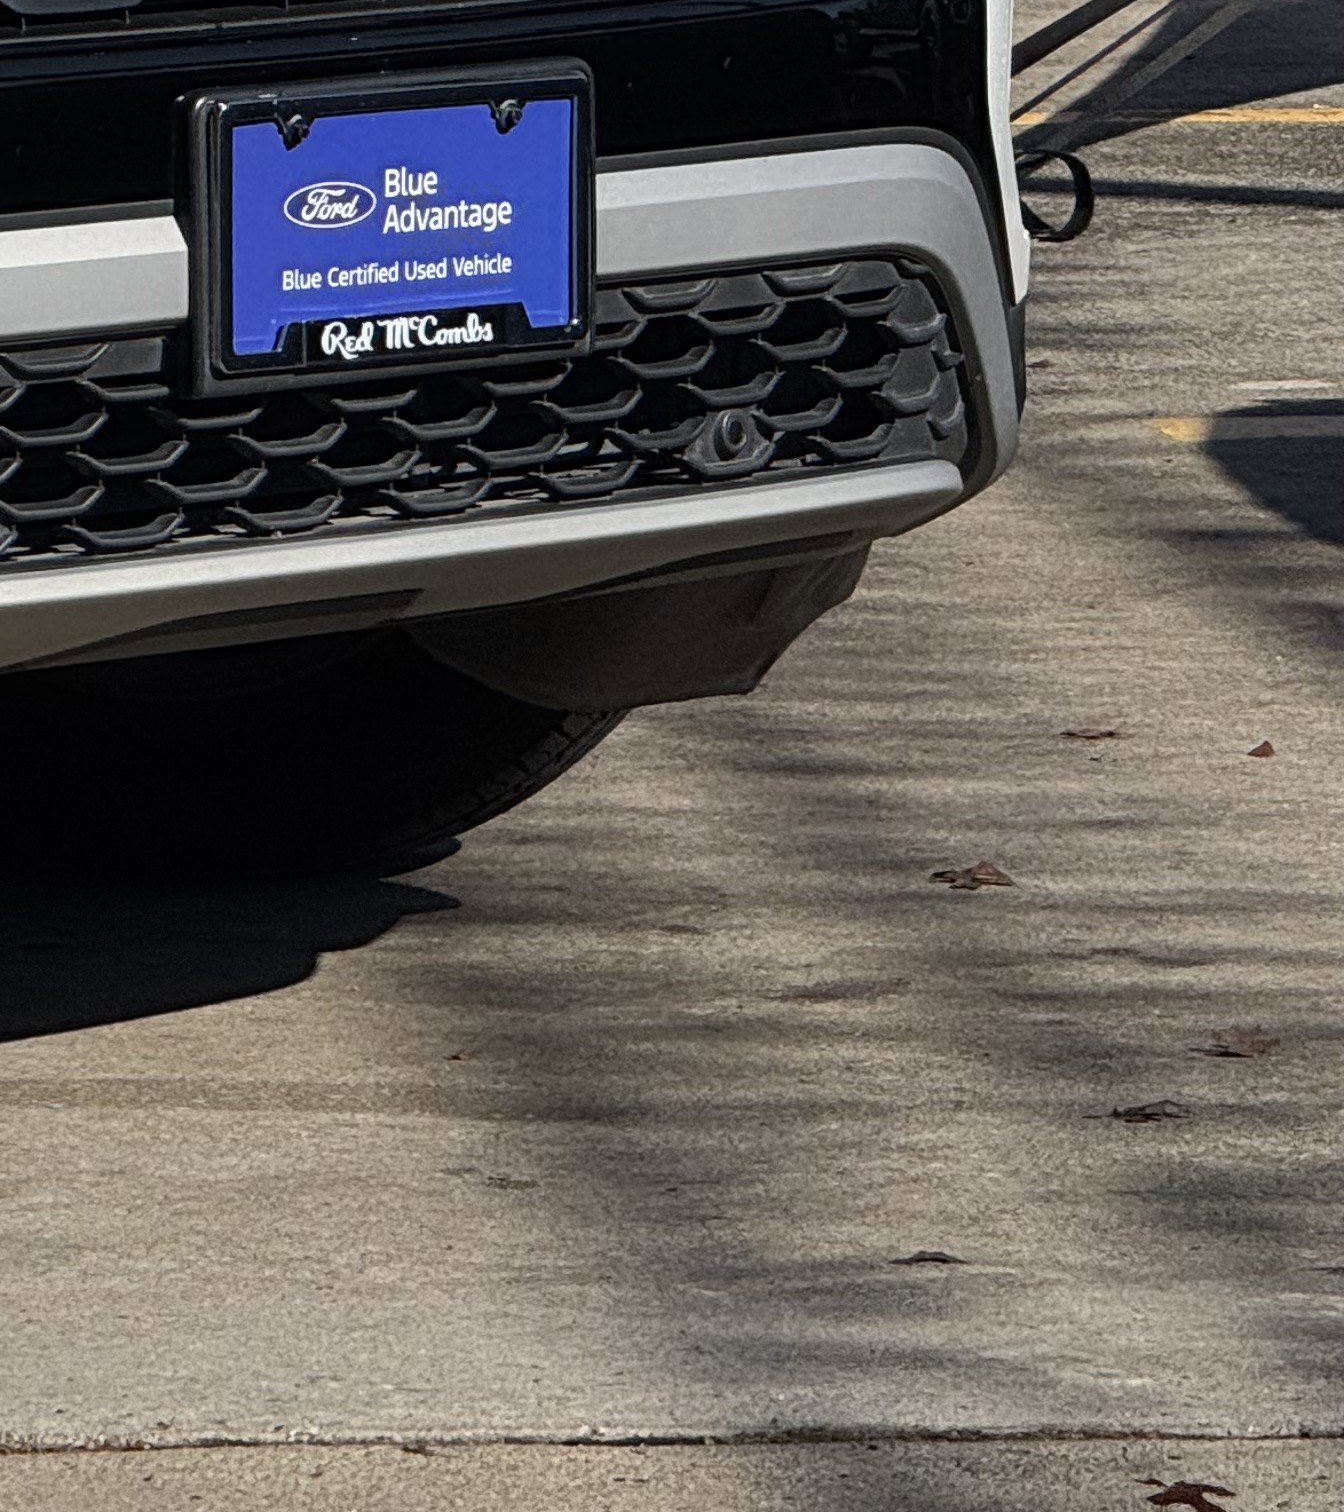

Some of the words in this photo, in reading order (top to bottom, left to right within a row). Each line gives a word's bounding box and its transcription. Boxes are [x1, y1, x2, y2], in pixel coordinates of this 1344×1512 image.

[385, 166, 439, 198] Blue
[302, 188, 359, 222] Ford
[383, 201, 512, 234] Advantage
[282, 269, 322, 291] Blue
[327, 261, 399, 286] Certified
[405, 261, 448, 281] Used
[452, 253, 512, 276] Vehicle
[321, 320, 373, 360] Red
